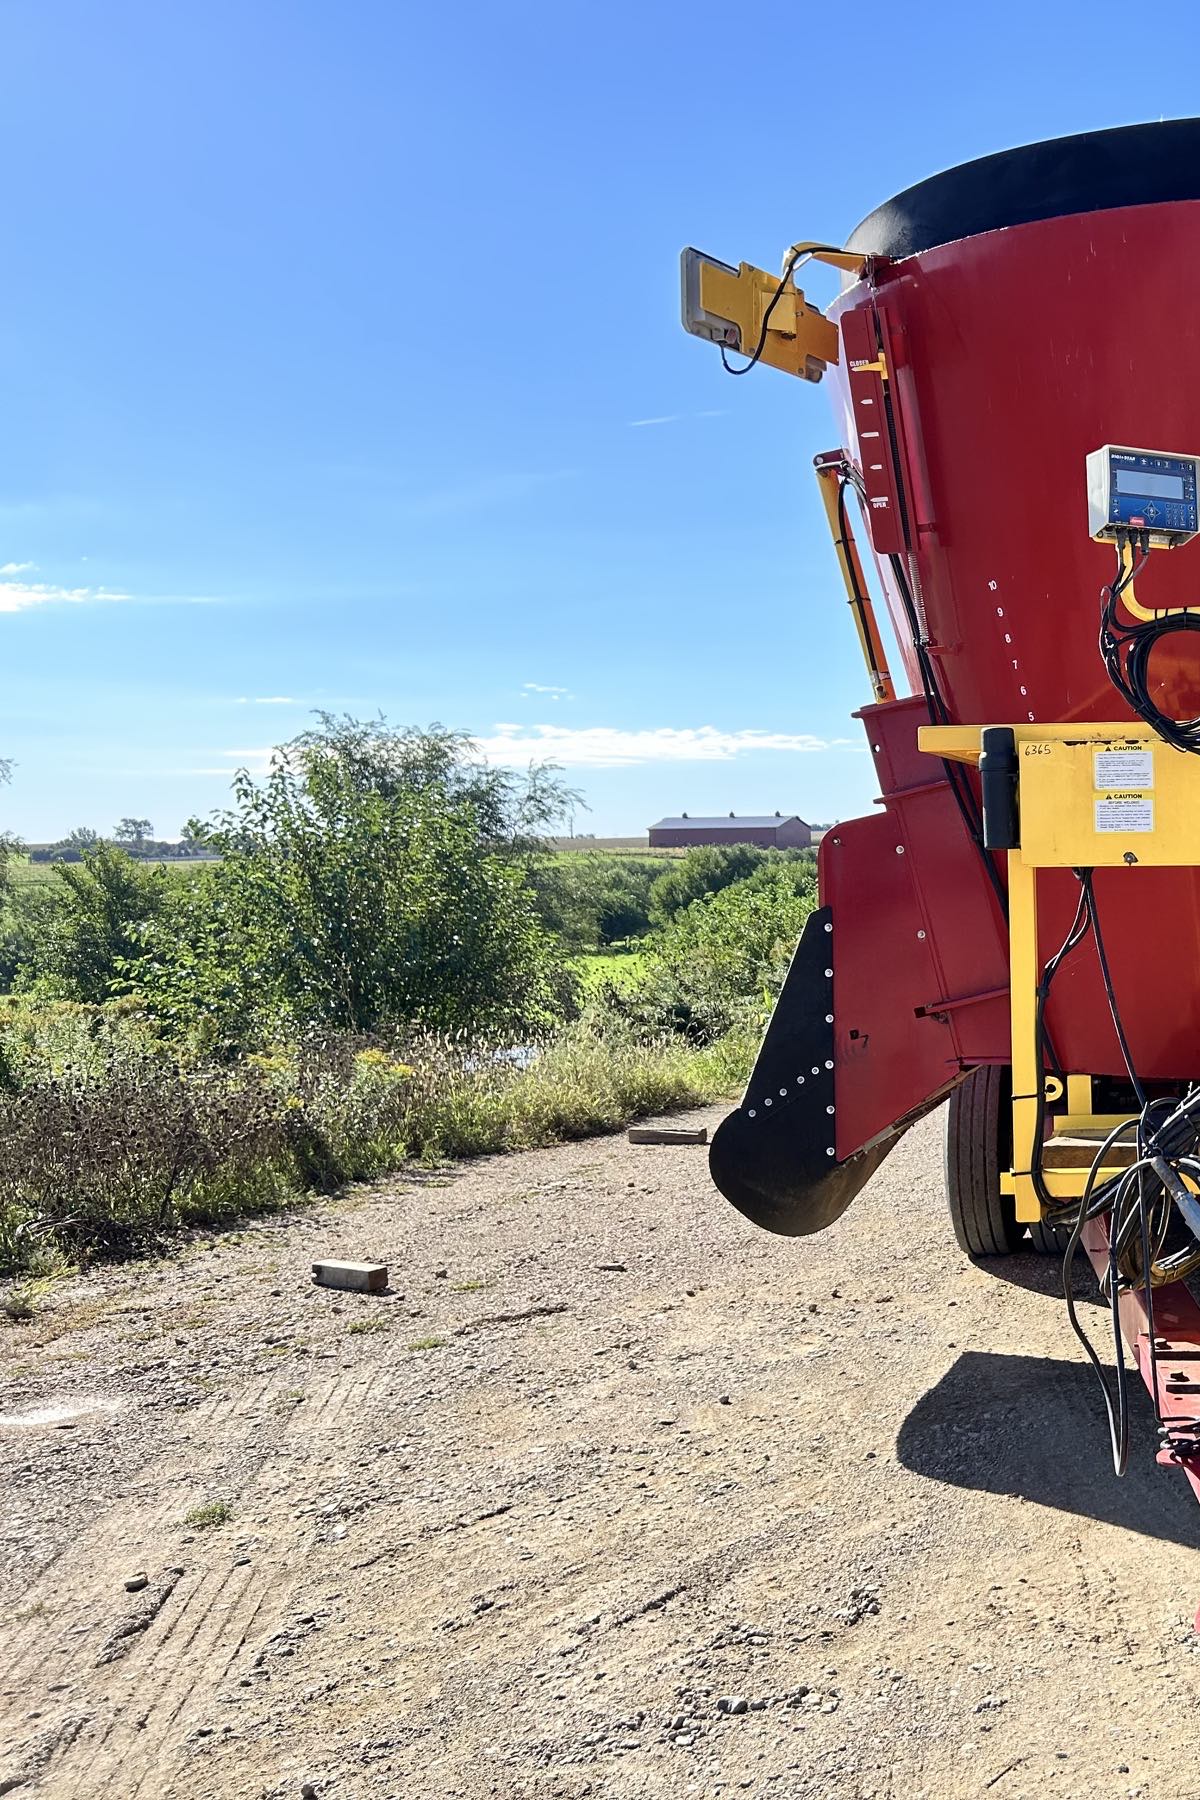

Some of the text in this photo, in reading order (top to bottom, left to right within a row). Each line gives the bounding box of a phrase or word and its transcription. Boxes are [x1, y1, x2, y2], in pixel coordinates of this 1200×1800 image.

[988, 580, 997, 591] 10
[997, 607, 1004, 617] 9
[1004, 633, 1011, 643] 8
[1012, 659, 1018, 669] 7
[1020, 686, 1027, 696] 6
[1028, 711, 1035, 721] 5
[1025, 744, 1051, 756] 6365
